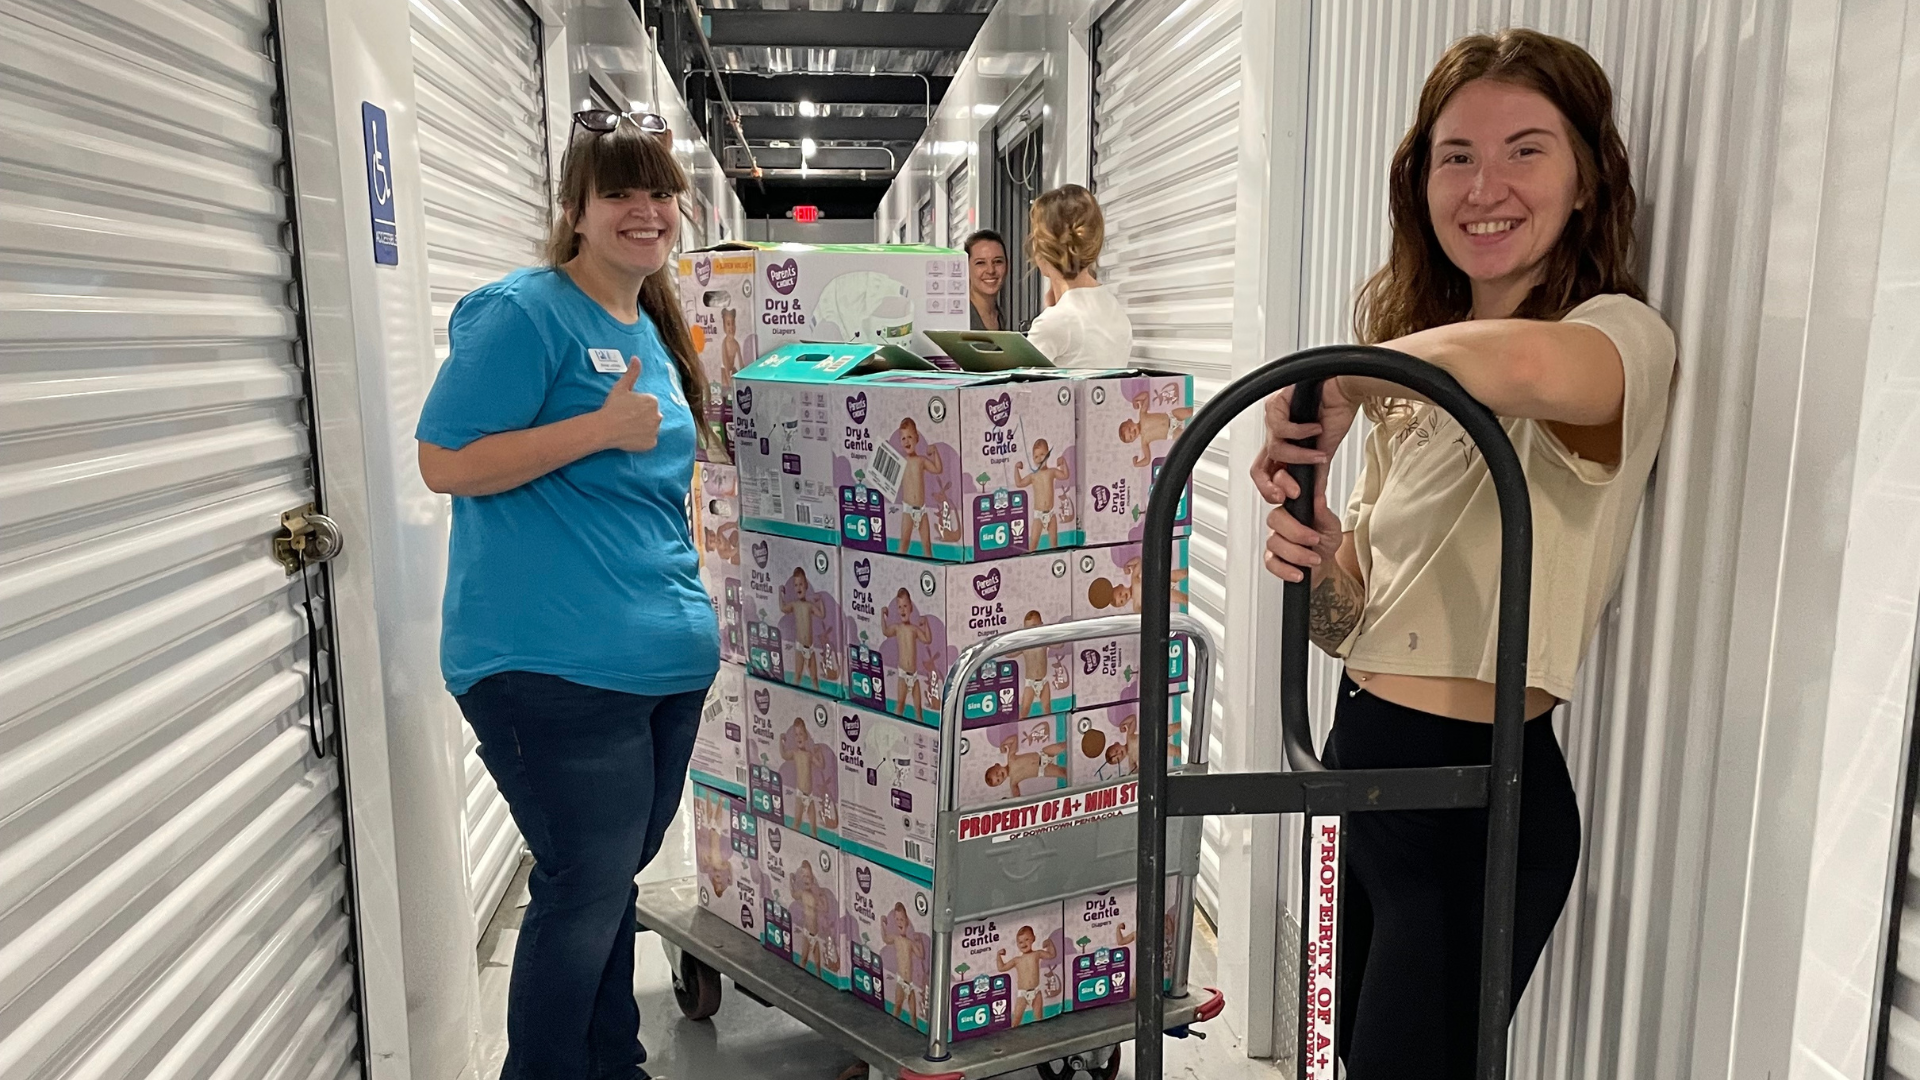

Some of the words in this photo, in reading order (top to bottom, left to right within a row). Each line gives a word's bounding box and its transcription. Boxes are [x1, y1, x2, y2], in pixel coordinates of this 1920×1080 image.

[770, 265, 797, 282] Parent's
[765, 298, 788, 313] Dry
[792, 298, 802, 310] &
[762, 311, 805, 325] Gentle
[772, 328, 796, 336] Diapers
[736, 417, 748, 428] Dry
[750, 418, 755, 427] &
[735, 428, 757, 440] Gentle
[845, 426, 862, 440] Dry
[864, 428, 870, 439] &
[984, 431, 1004, 444] Dry
[1006, 429, 1014, 440] &
[844, 438, 873, 452] Gentle
[982, 442, 1017, 456] Gentle
[1111, 482, 1119, 490] &
[1111, 493, 1120, 513] Dry
[1118, 478, 1126, 515] Gentle
[857, 518, 867, 537] 6
[995, 525, 1006, 545] 6
[751, 569, 764, 583] Dry
[766, 572, 771, 582] &
[976, 573, 999, 591] Parent's
[750, 580, 773, 594] Gentle
[853, 588, 866, 603] Dry
[867, 592, 873, 603] &
[851, 600, 875, 615] Gentle
[971, 605, 992, 617] Dry
[995, 602, 1004, 613] &
[968, 615, 1007, 629] Gentle
[977, 629, 999, 637] Diapers
[1102, 644, 1109, 653] &
[761, 652, 769, 668] 6
[1102, 655, 1111, 675] Dry
[861, 677, 870, 695] 6
[981, 694, 994, 713] 6
[841, 741, 855, 756] Dry
[857, 746, 862, 756] &
[839, 752, 864, 768] Gentle
[762, 794, 770, 810] 6
[959, 804, 1040, 841] PROPERTY
[1041, 799, 1060, 823] OF
[1061, 797, 1082, 819] A+
[1084, 786, 1118, 813] MINI
[1009, 832, 1022, 841] OF
[1023, 821, 1073, 838] DOWNTOWN
[1085, 898, 1105, 911] Dry
[1108, 896, 1117, 906] &
[1318, 824, 1337, 979] PROPERTY
[1083, 907, 1119, 922] Gentle
[964, 924, 985, 937] Dry
[988, 921, 997, 931] &
[1091, 920, 1112, 929] Diapers
[774, 929, 781, 945] 6
[961, 932, 1000, 949] Gentle
[970, 946, 992, 955] Diapers
[1307, 941, 1317, 965] OF
[863, 974, 871, 991] 6
[1094, 978, 1106, 996] 6
[1317, 987, 1332, 1025] OF
[974, 1007, 987, 1025] 6
[1306, 969, 1317, 1068] DOWNTOWN
[1316, 1032, 1331, 1070] A+
